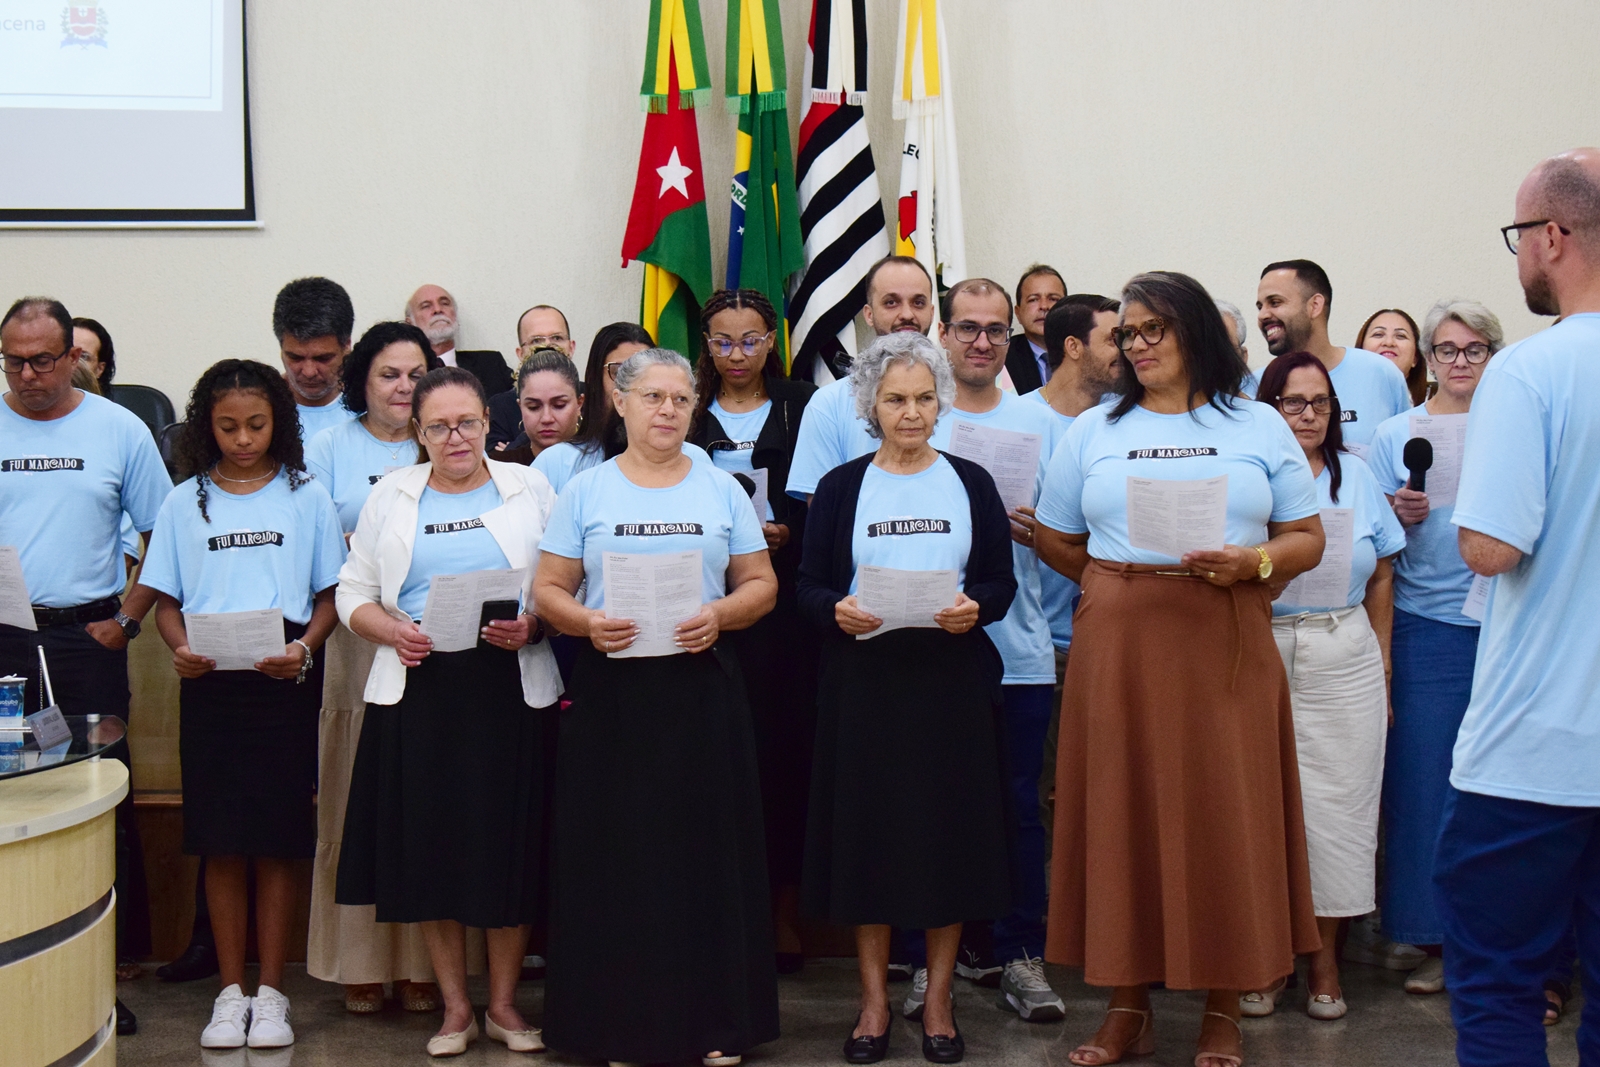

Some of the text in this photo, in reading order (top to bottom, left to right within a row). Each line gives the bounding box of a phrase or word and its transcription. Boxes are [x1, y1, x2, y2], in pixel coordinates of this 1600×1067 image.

[0, 19, 46, 31] cena
[1340, 411, 1352, 421] DO
[1136, 447, 1210, 460] FUI MARCADO
[9, 458, 78, 472] FUI MARCADO
[433, 519, 484, 534] FUI MARC
[623, 523, 696, 536] FUI MARCADO
[875, 520, 944, 537] FUI MARCADO
[215, 531, 278, 550] FUI MARCADO
